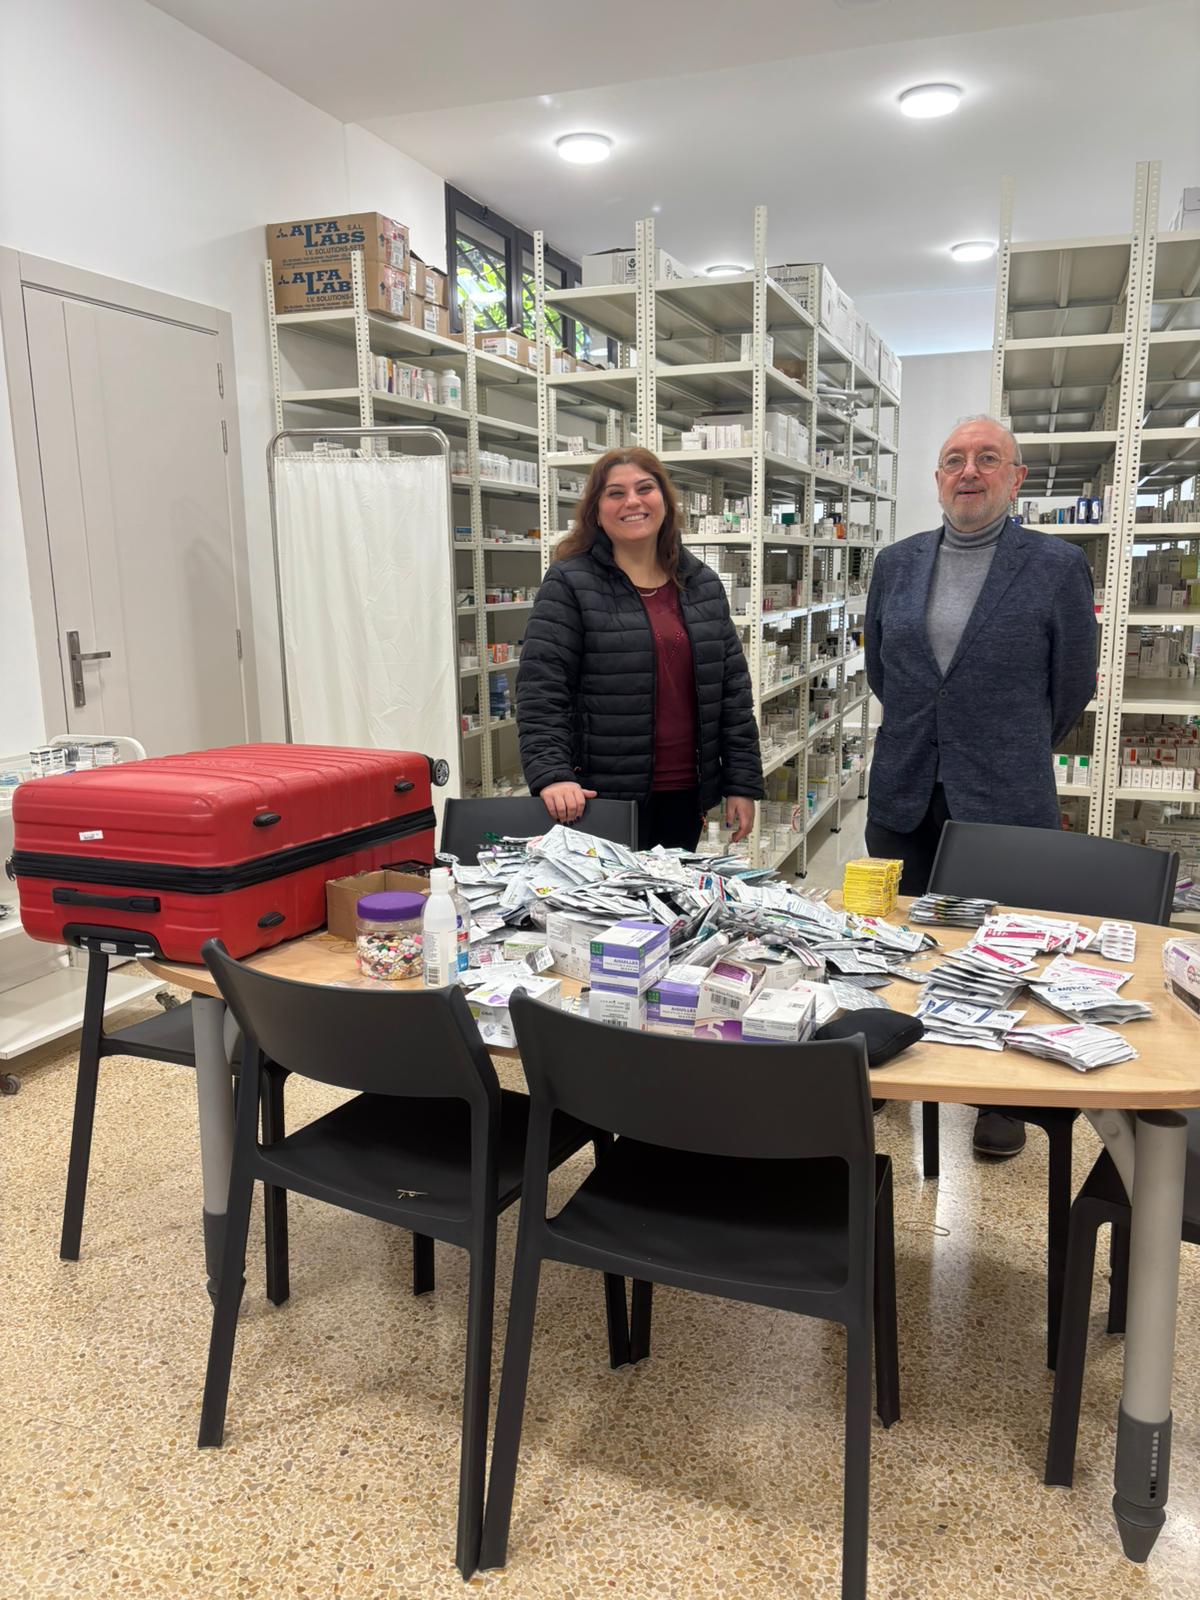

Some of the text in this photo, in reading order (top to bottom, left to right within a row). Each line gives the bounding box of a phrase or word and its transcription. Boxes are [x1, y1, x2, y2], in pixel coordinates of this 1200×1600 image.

[290, 220, 340, 247] ALFA
[304, 226, 365, 248] LABS
[291, 269, 342, 294] ALFA
[306, 273, 353, 295] LAB
